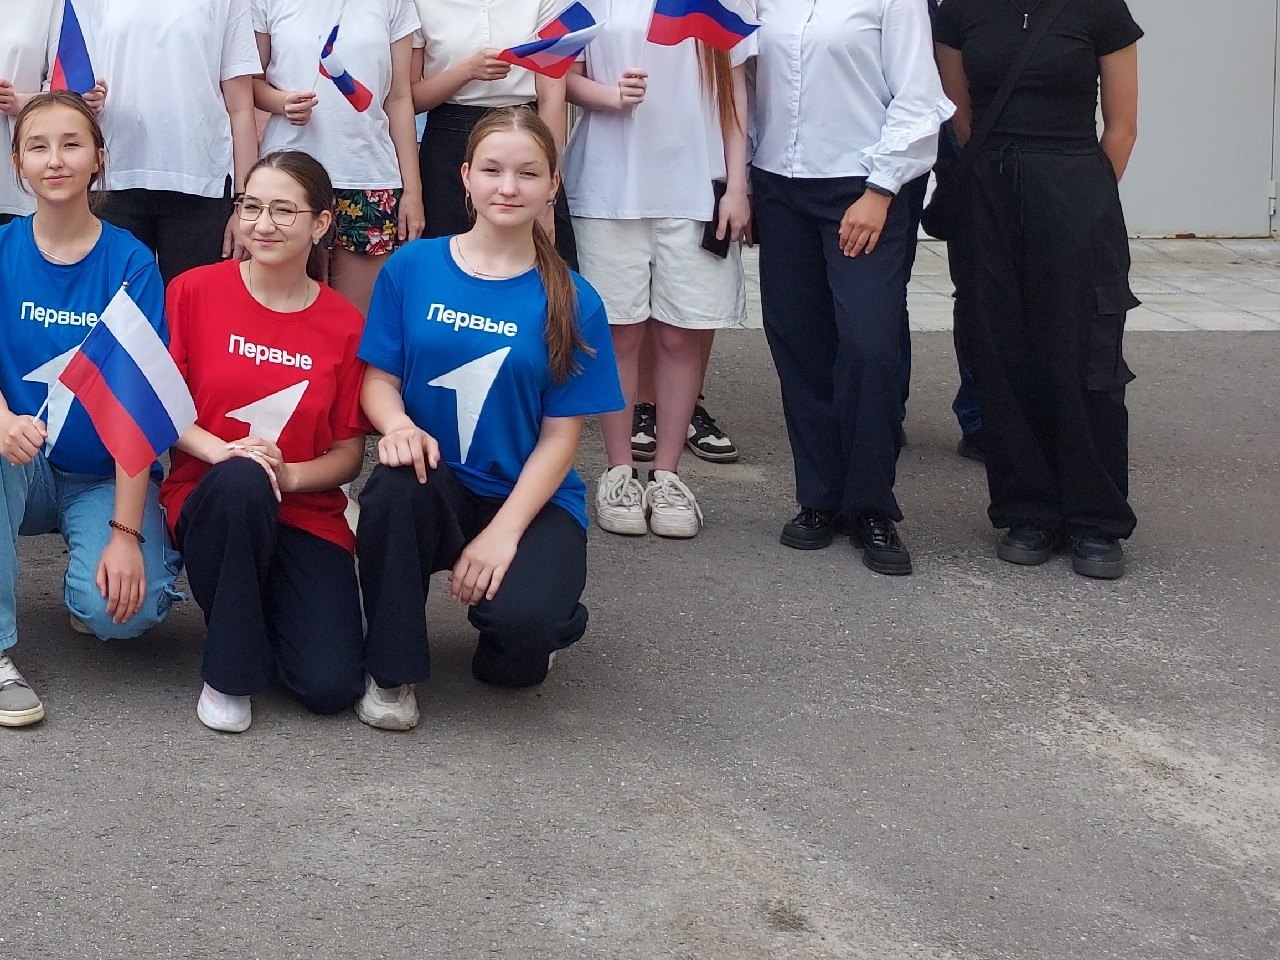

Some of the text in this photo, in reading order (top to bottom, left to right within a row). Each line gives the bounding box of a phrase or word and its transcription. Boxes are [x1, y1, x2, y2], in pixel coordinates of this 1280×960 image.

[20, 302, 98, 328] Первые
[426, 303, 518, 337] Первые
[228, 334, 313, 371] Первые
